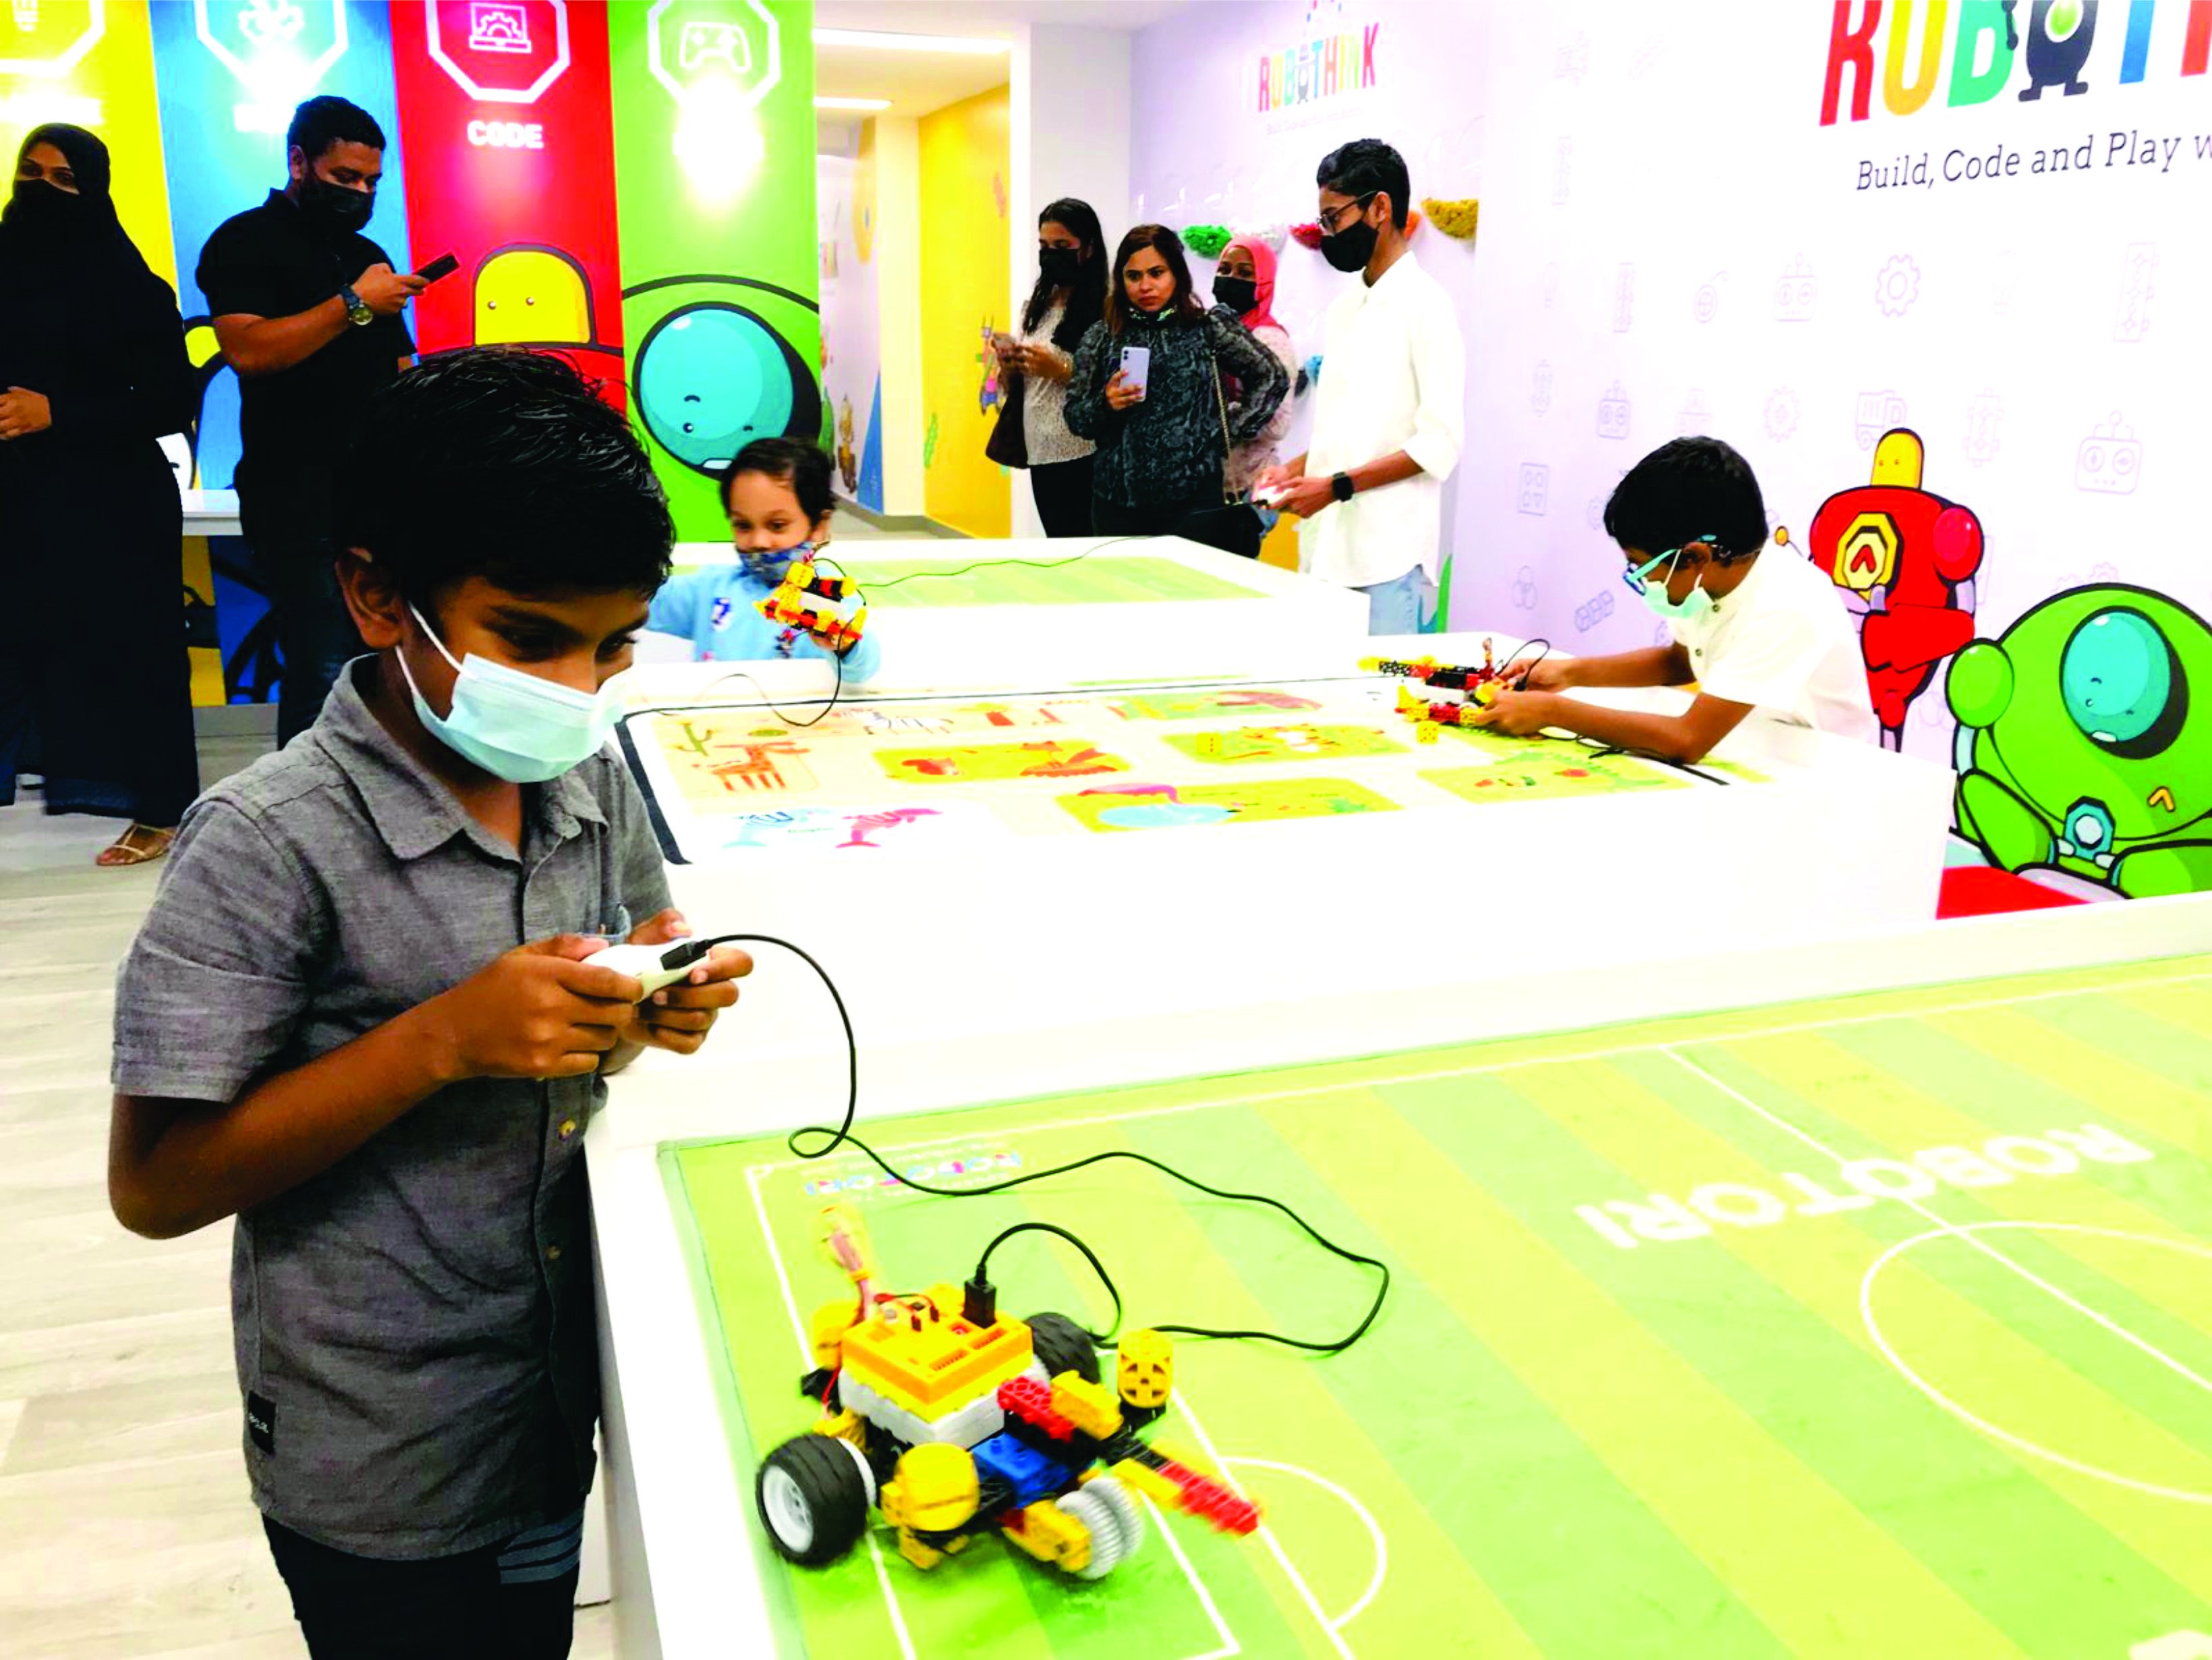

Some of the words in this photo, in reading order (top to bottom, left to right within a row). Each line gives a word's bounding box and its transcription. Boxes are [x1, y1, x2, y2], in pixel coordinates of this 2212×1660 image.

[467, 119, 544, 148] CODE
[1856, 153, 1934, 190] Build,
[1944, 144, 2020, 182] Code
[2031, 134, 2093, 173] and
[2105, 130, 2182, 173] Play
[1574, 1123, 2156, 1250] ROBOTORI
